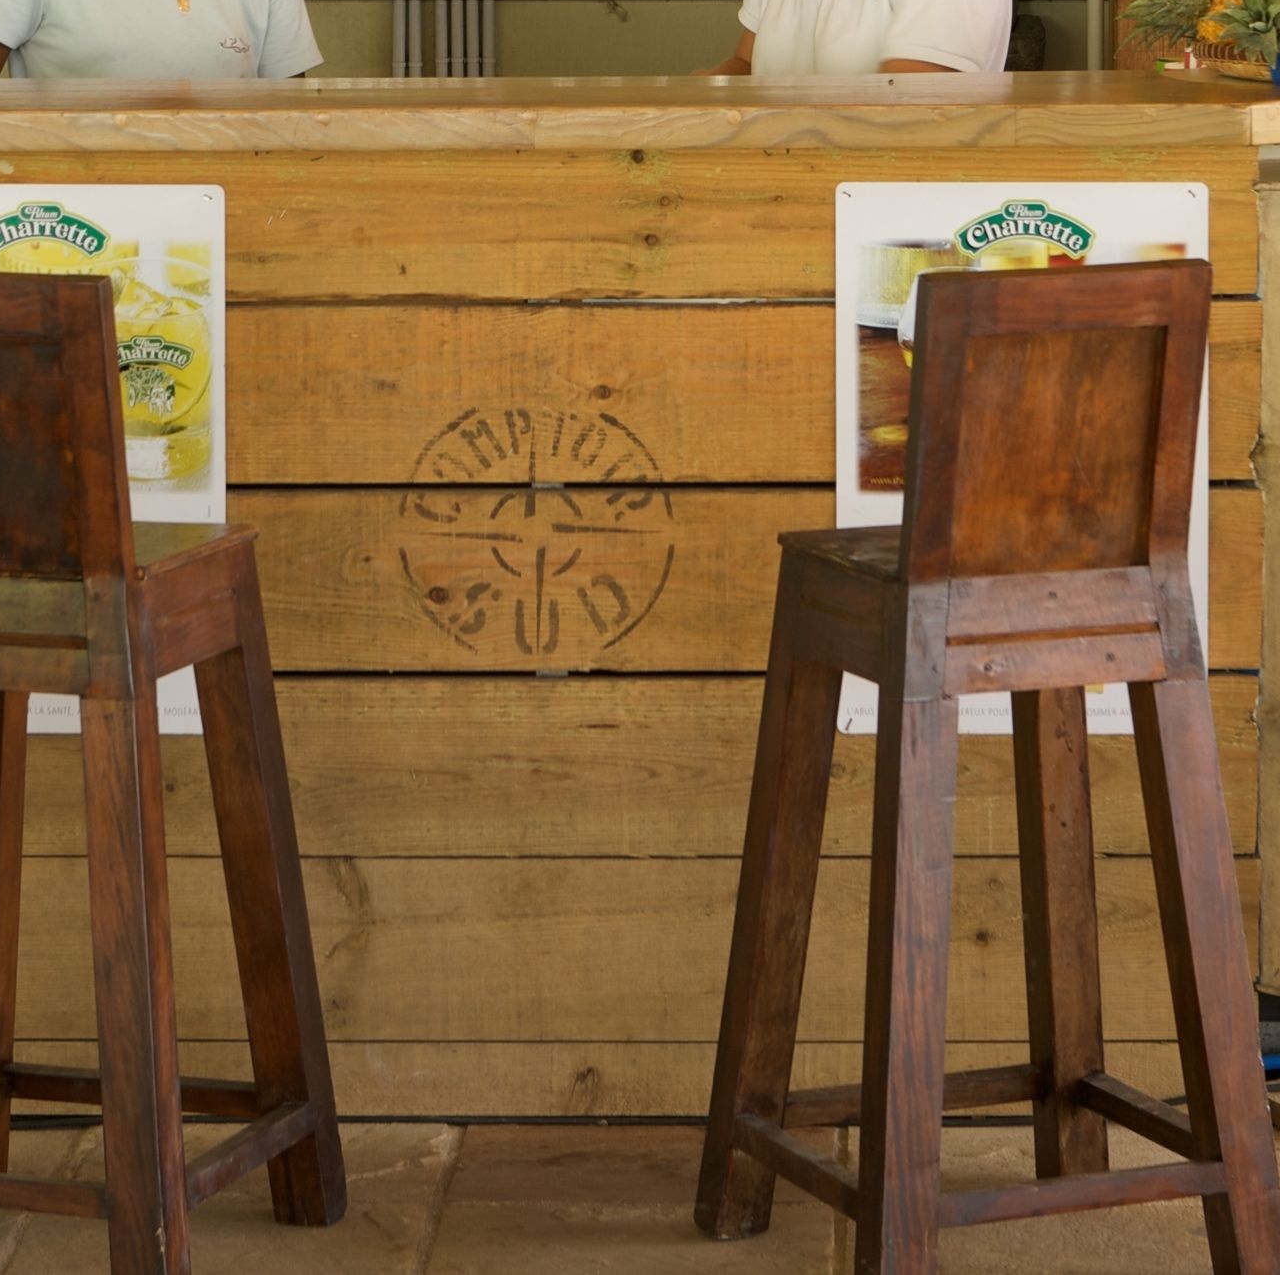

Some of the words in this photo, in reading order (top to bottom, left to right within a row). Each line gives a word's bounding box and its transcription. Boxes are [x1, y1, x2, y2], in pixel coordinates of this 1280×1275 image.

[966, 219, 1083, 251] Charrette
[117, 346, 188, 365] harrette
[447, 574, 631, 656] SUD
